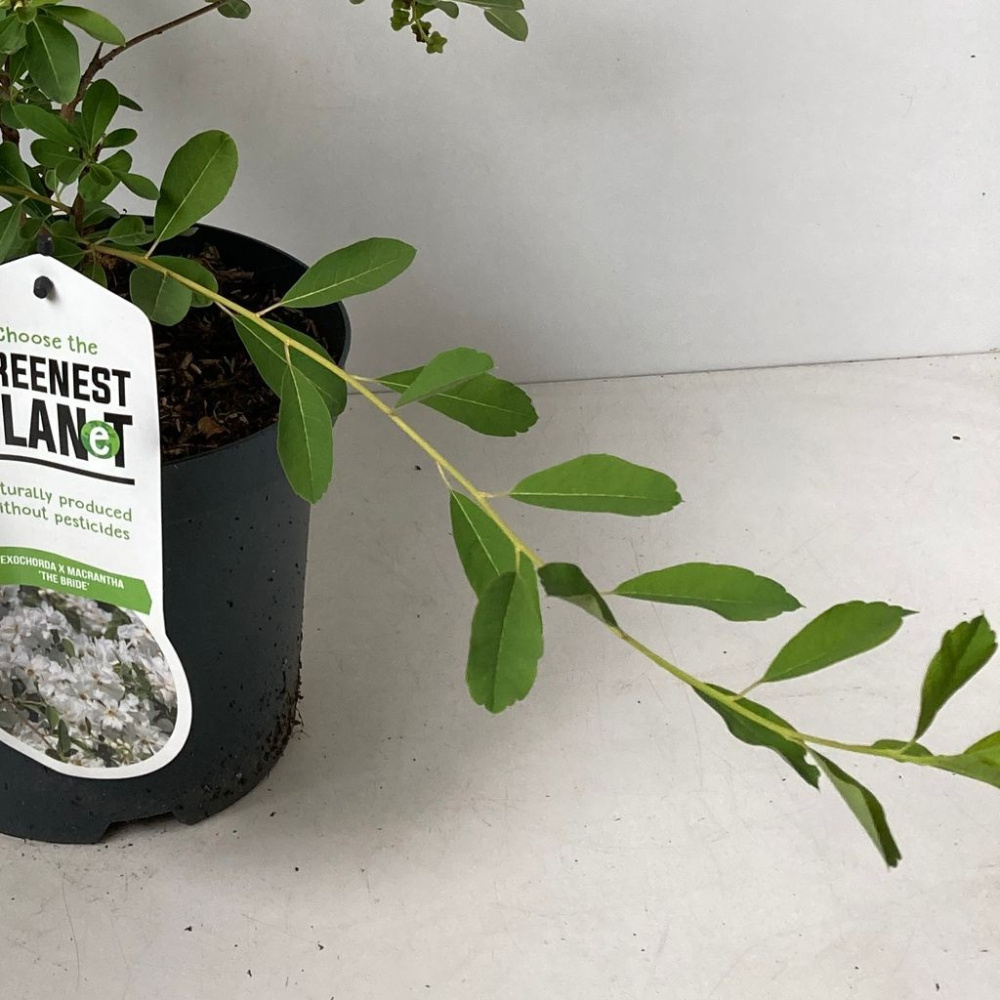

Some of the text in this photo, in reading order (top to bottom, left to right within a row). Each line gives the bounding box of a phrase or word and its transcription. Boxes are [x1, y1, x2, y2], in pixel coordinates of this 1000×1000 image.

[68, 335, 98, 355] the
[59, 495, 132, 522] produced
[55, 512, 130, 540] pesticides
[0, 555, 124, 589] EXOCHORDA X MACRANTHA
